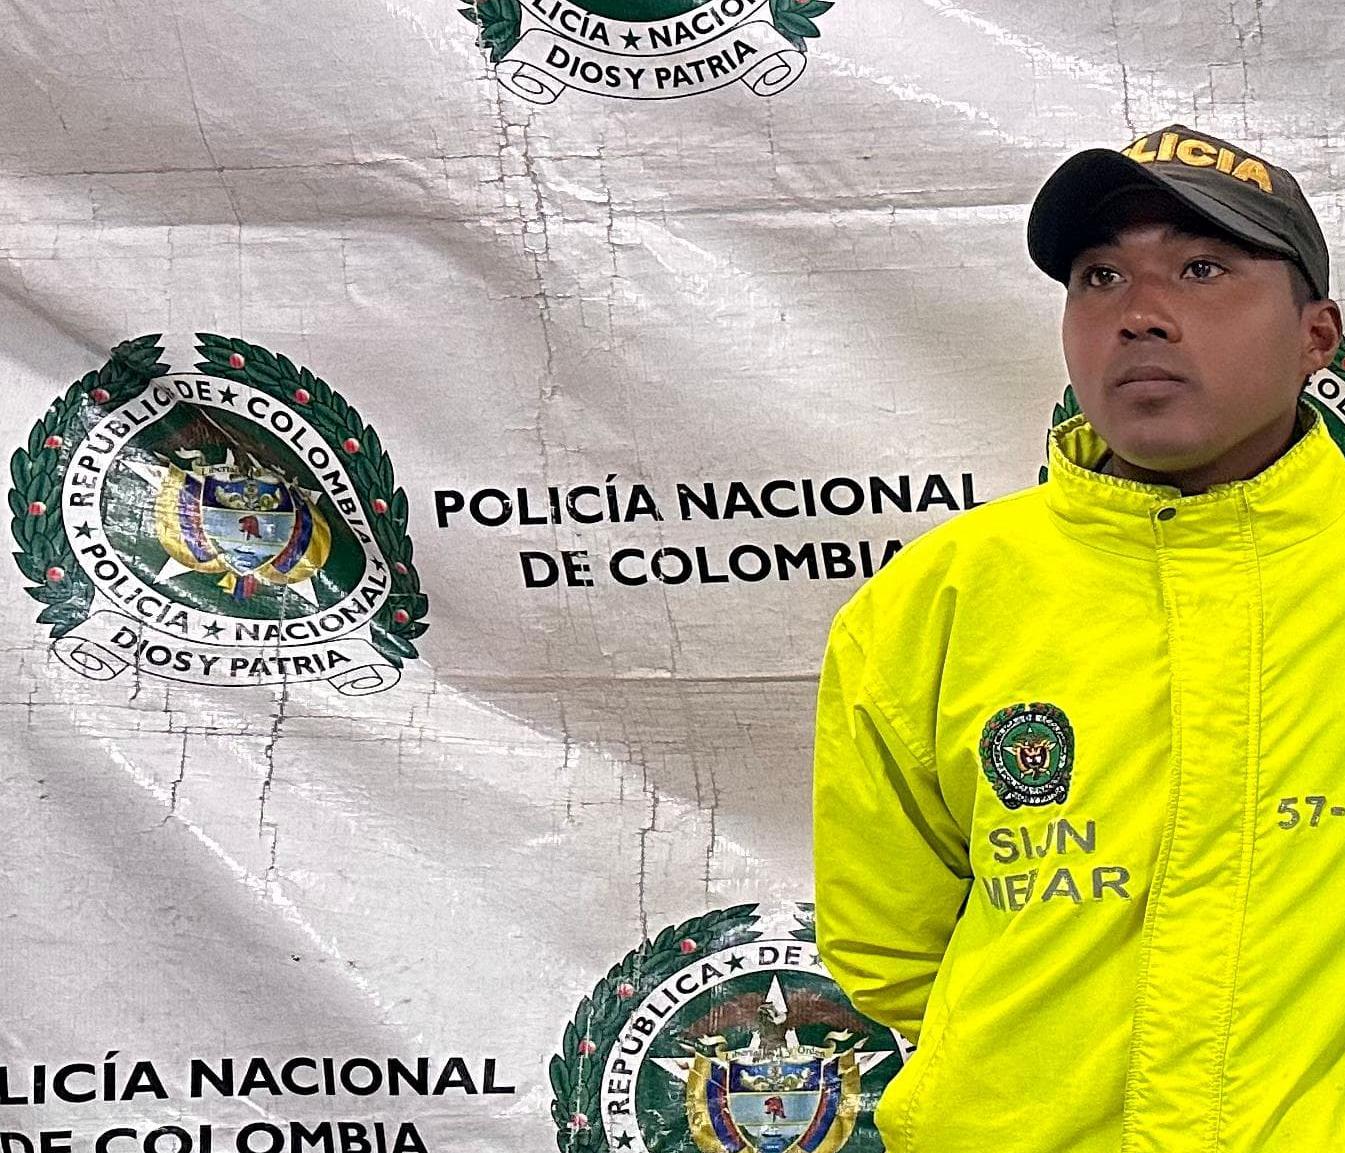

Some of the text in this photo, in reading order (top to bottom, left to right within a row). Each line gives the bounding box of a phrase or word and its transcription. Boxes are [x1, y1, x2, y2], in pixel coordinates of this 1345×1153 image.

[529, 0, 757, 48] LICÍA NACIO
[545, 39, 758, 90] DIOS Y PATRIA
[1122, 132, 1273, 194] LICIA
[174, 379, 212, 401] DE
[247, 396, 370, 546] COLOMBIA
[434, 472, 987, 528] POLICÍA NACIONAL
[82, 544, 388, 643] POLICÍA NACIONAL
[519, 549, 594, 588] DE
[110, 625, 352, 679] DIOS Y PATRIA
[988, 818, 1096, 864] SIJN
[608, 946, 803, 1117] REPÚBLICA DE
[0, 1050, 516, 1106] LICÍA NACIONAL
